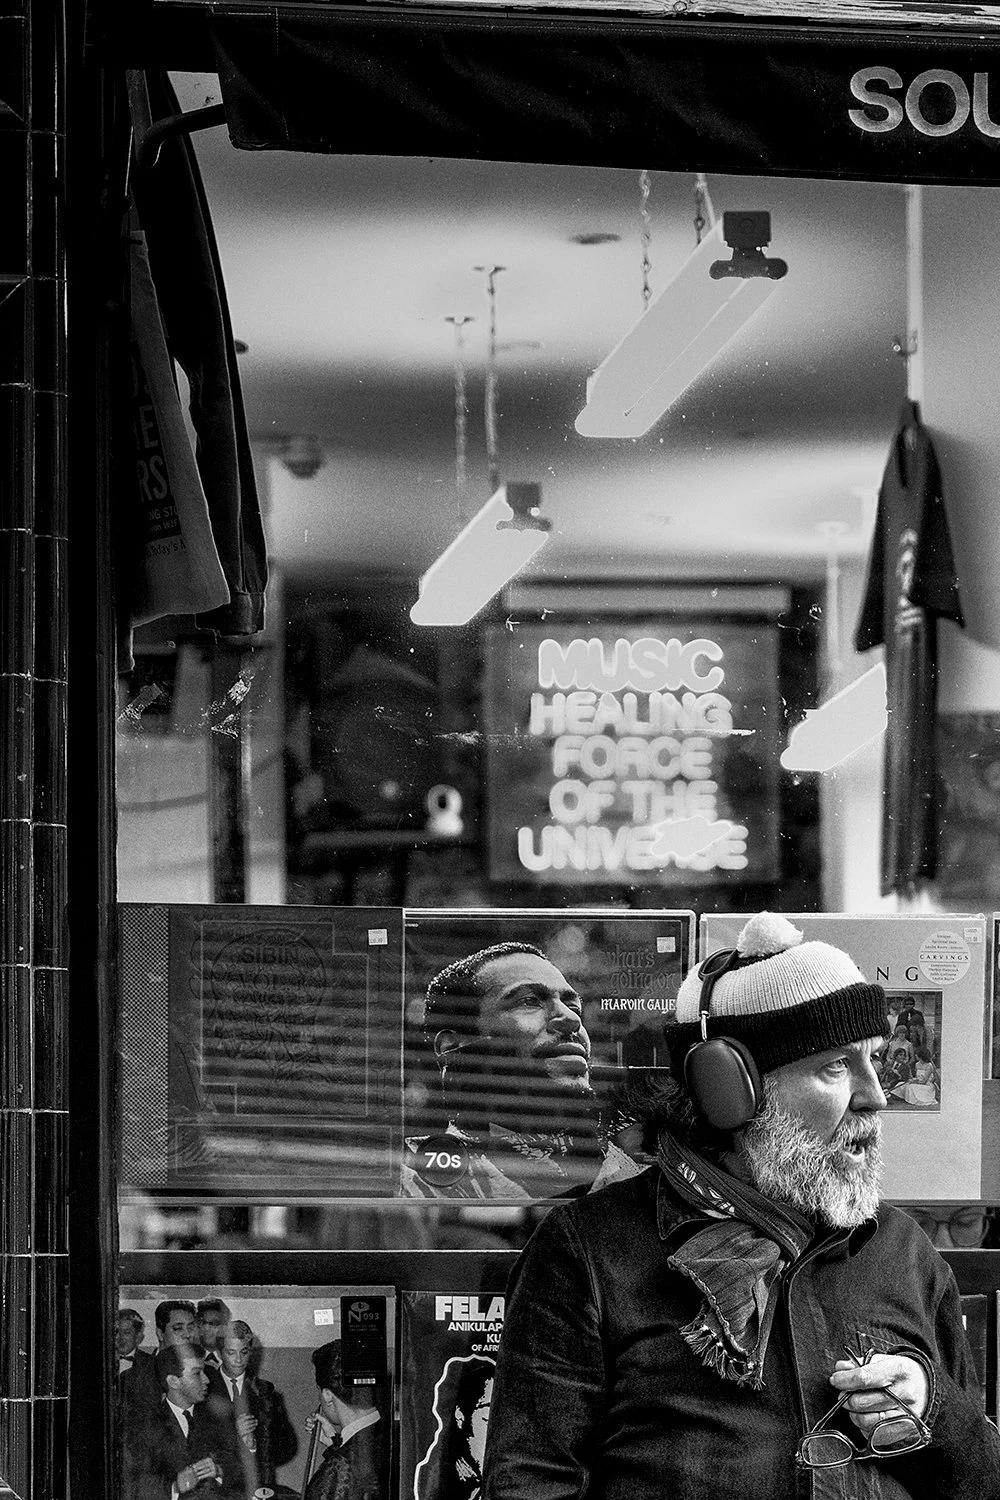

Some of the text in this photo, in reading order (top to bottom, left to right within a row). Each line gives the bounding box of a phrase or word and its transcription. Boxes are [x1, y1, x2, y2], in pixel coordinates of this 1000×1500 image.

[538, 637, 725, 693] MUSIC
[529, 691, 734, 738] HEALING
[553, 735, 713, 780] FORCE
[549, 779, 719, 824] OF THE
[517, 824, 749, 872] UNIVEE
[919, 953, 970, 961] CARVINGS
[600, 997, 677, 1015] MARVIN GAYE
[424, 1151, 463, 1169] 70s
[363, 1312, 380, 1321] 093
[435, 1295, 505, 1322] FELA
[471, 1343, 483, 1352] OF
